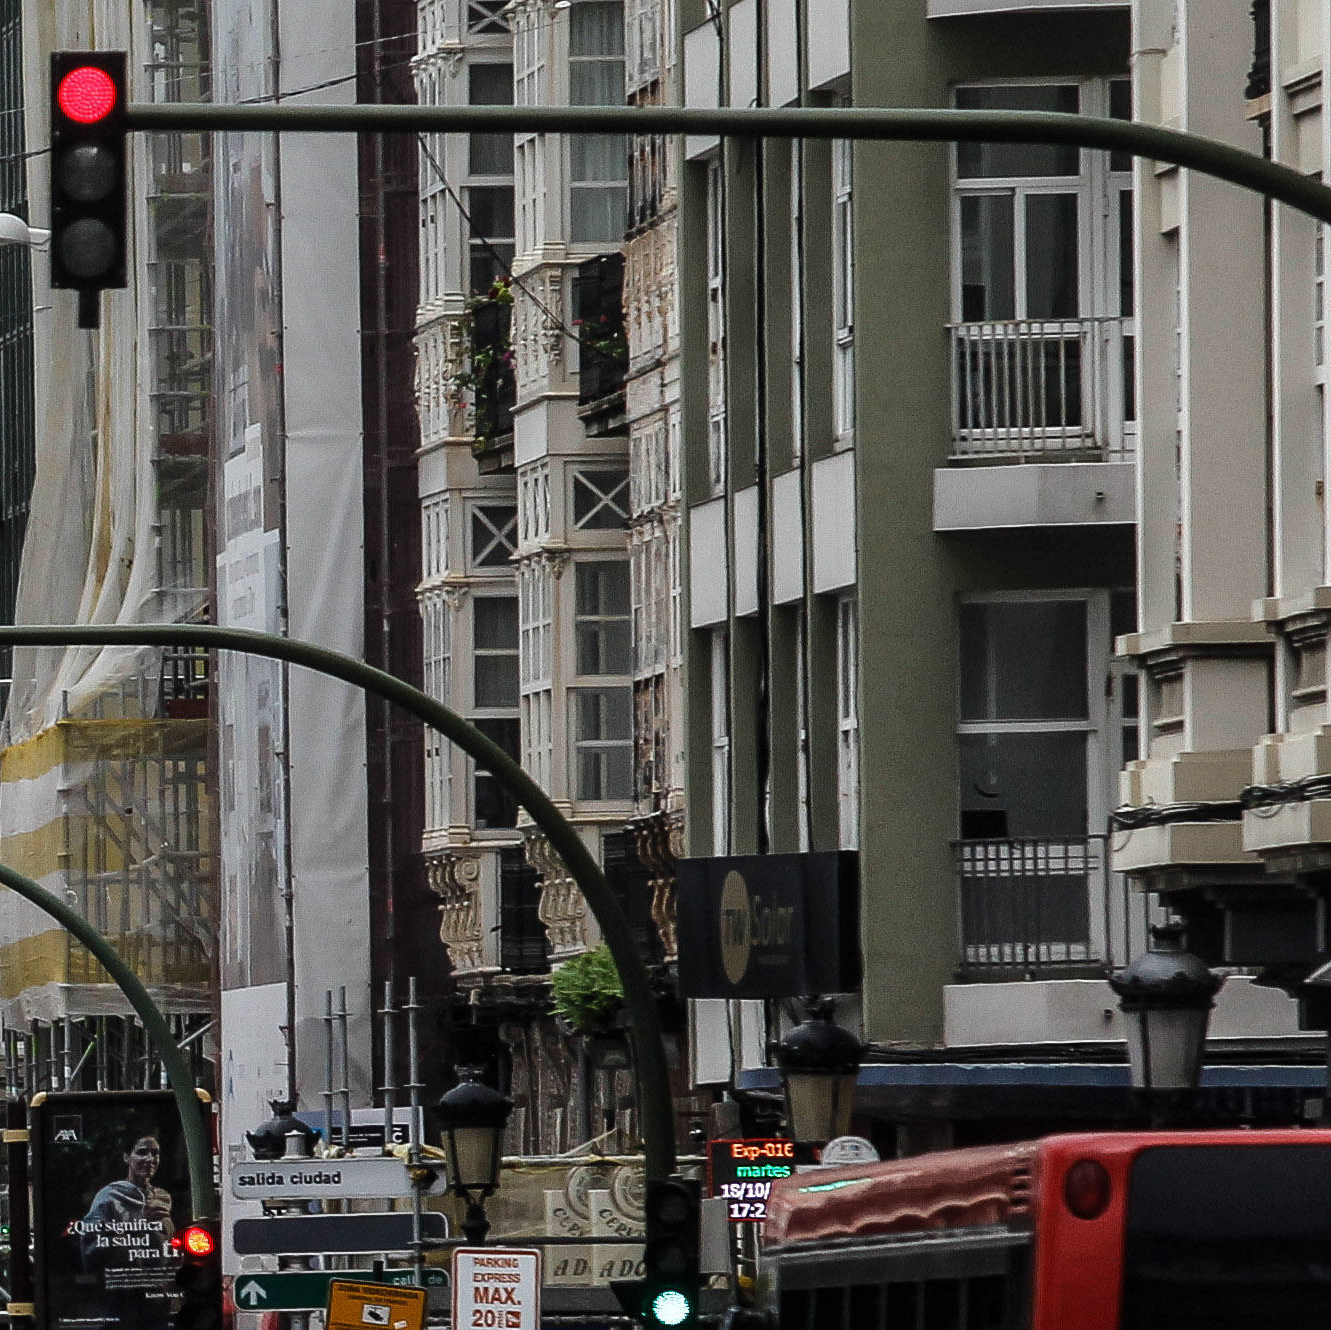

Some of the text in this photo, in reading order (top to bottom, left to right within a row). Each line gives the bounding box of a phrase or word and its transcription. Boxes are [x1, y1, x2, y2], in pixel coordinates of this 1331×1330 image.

[736, 1163, 791, 1178] martes
[238, 1171, 342, 1186] salida ciudad
[729, 1203, 767, 1218] 17:2
[67, 1218, 164, 1236] ¿Qué significa
[96, 1233, 150, 1248] la salud
[128, 1249, 160, 1262] para
[473, 1257, 519, 1268] PARKING
[393, 1274, 443, 1286] call de
[472, 1272, 521, 1284] EXPRESS
[473, 1286, 522, 1306] MAX.
[471, 1309, 496, 1328] 20
